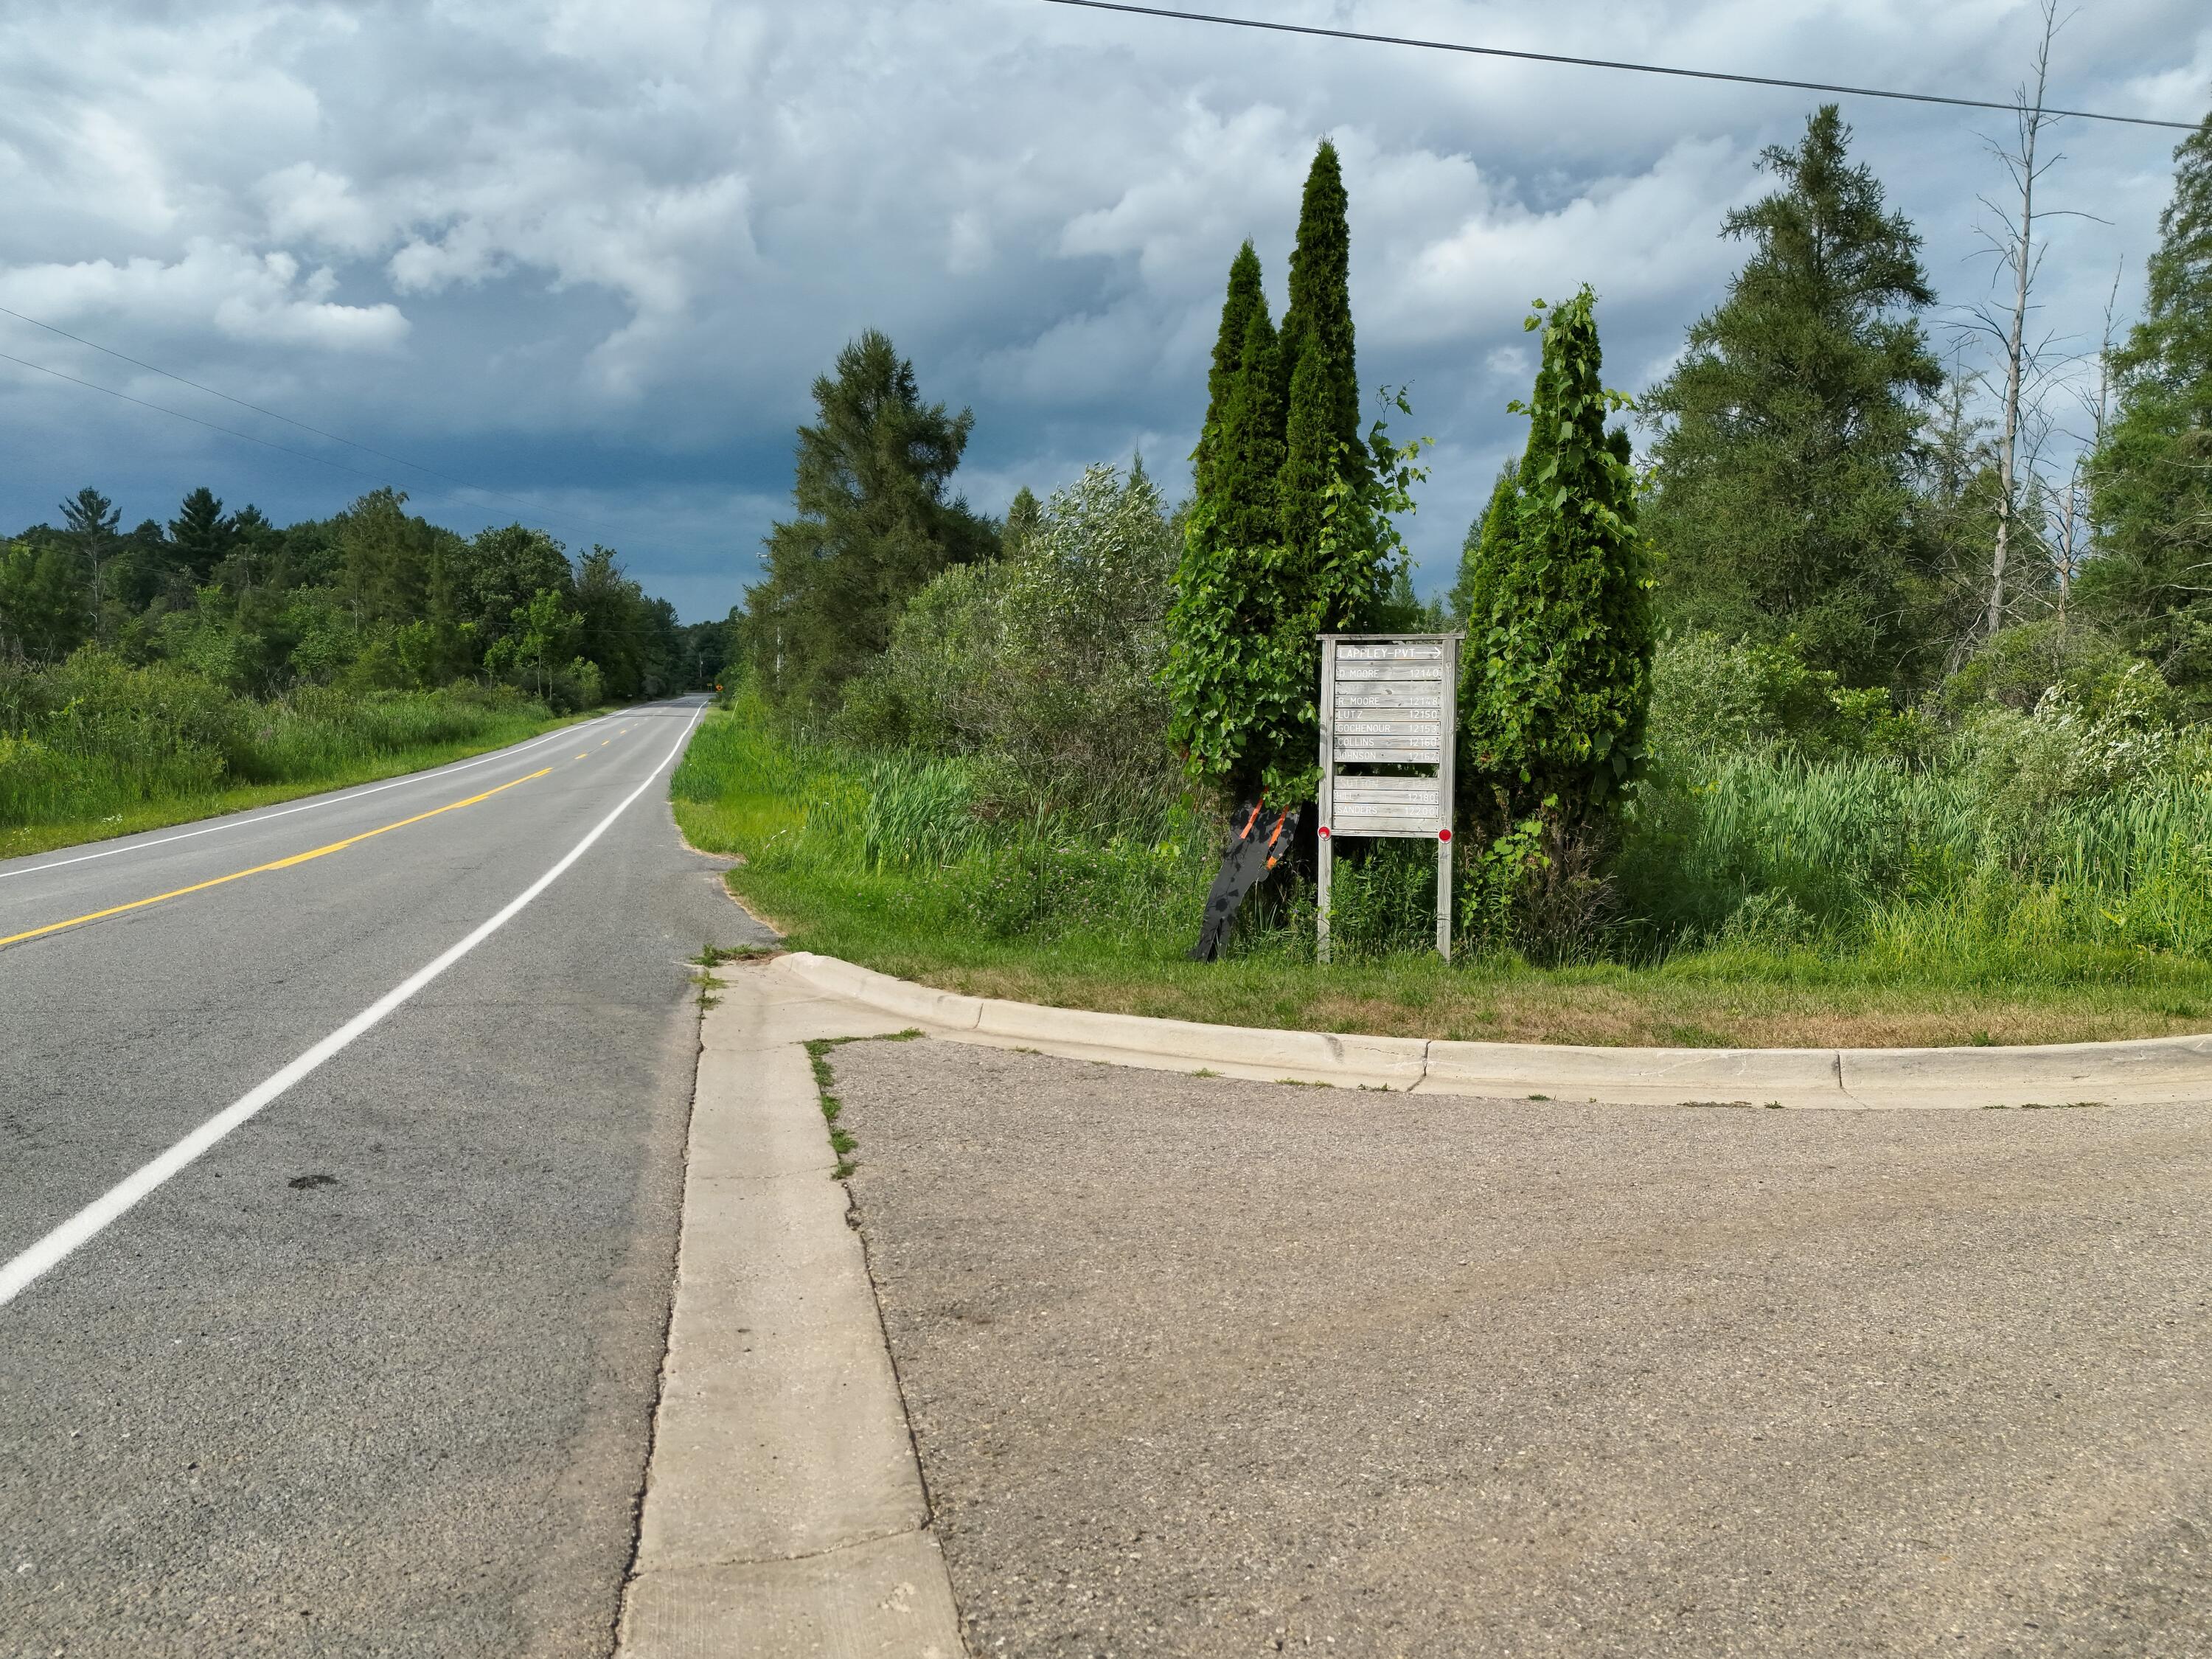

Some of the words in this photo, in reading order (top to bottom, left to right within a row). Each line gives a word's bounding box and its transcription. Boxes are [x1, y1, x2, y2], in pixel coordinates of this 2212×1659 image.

[1350, 669, 1380, 678] MOORE
[1411, 669, 1439, 678] 12140
[1350, 698, 1380, 706] MOORE
[1410, 698, 1438, 706] 12148
[1338, 711, 1363, 719] LUTZ
[1410, 710, 1437, 719] 12150
[1338, 724, 1391, 733] GOCHENOUR
[1409, 725, 1437, 733] 12153
[1338, 738, 1374, 746] COLLINS
[1409, 738, 1437, 747] 12160
[1338, 751, 1376, 760] JOHNSON
[1409, 752, 1436, 761] 12162
[1337, 793, 1354, 801] HILL
[1408, 793, 1436, 802] 12180
[1337, 805, 1378, 815] SANDERS
[1405, 807, 1436, 815] 12200
